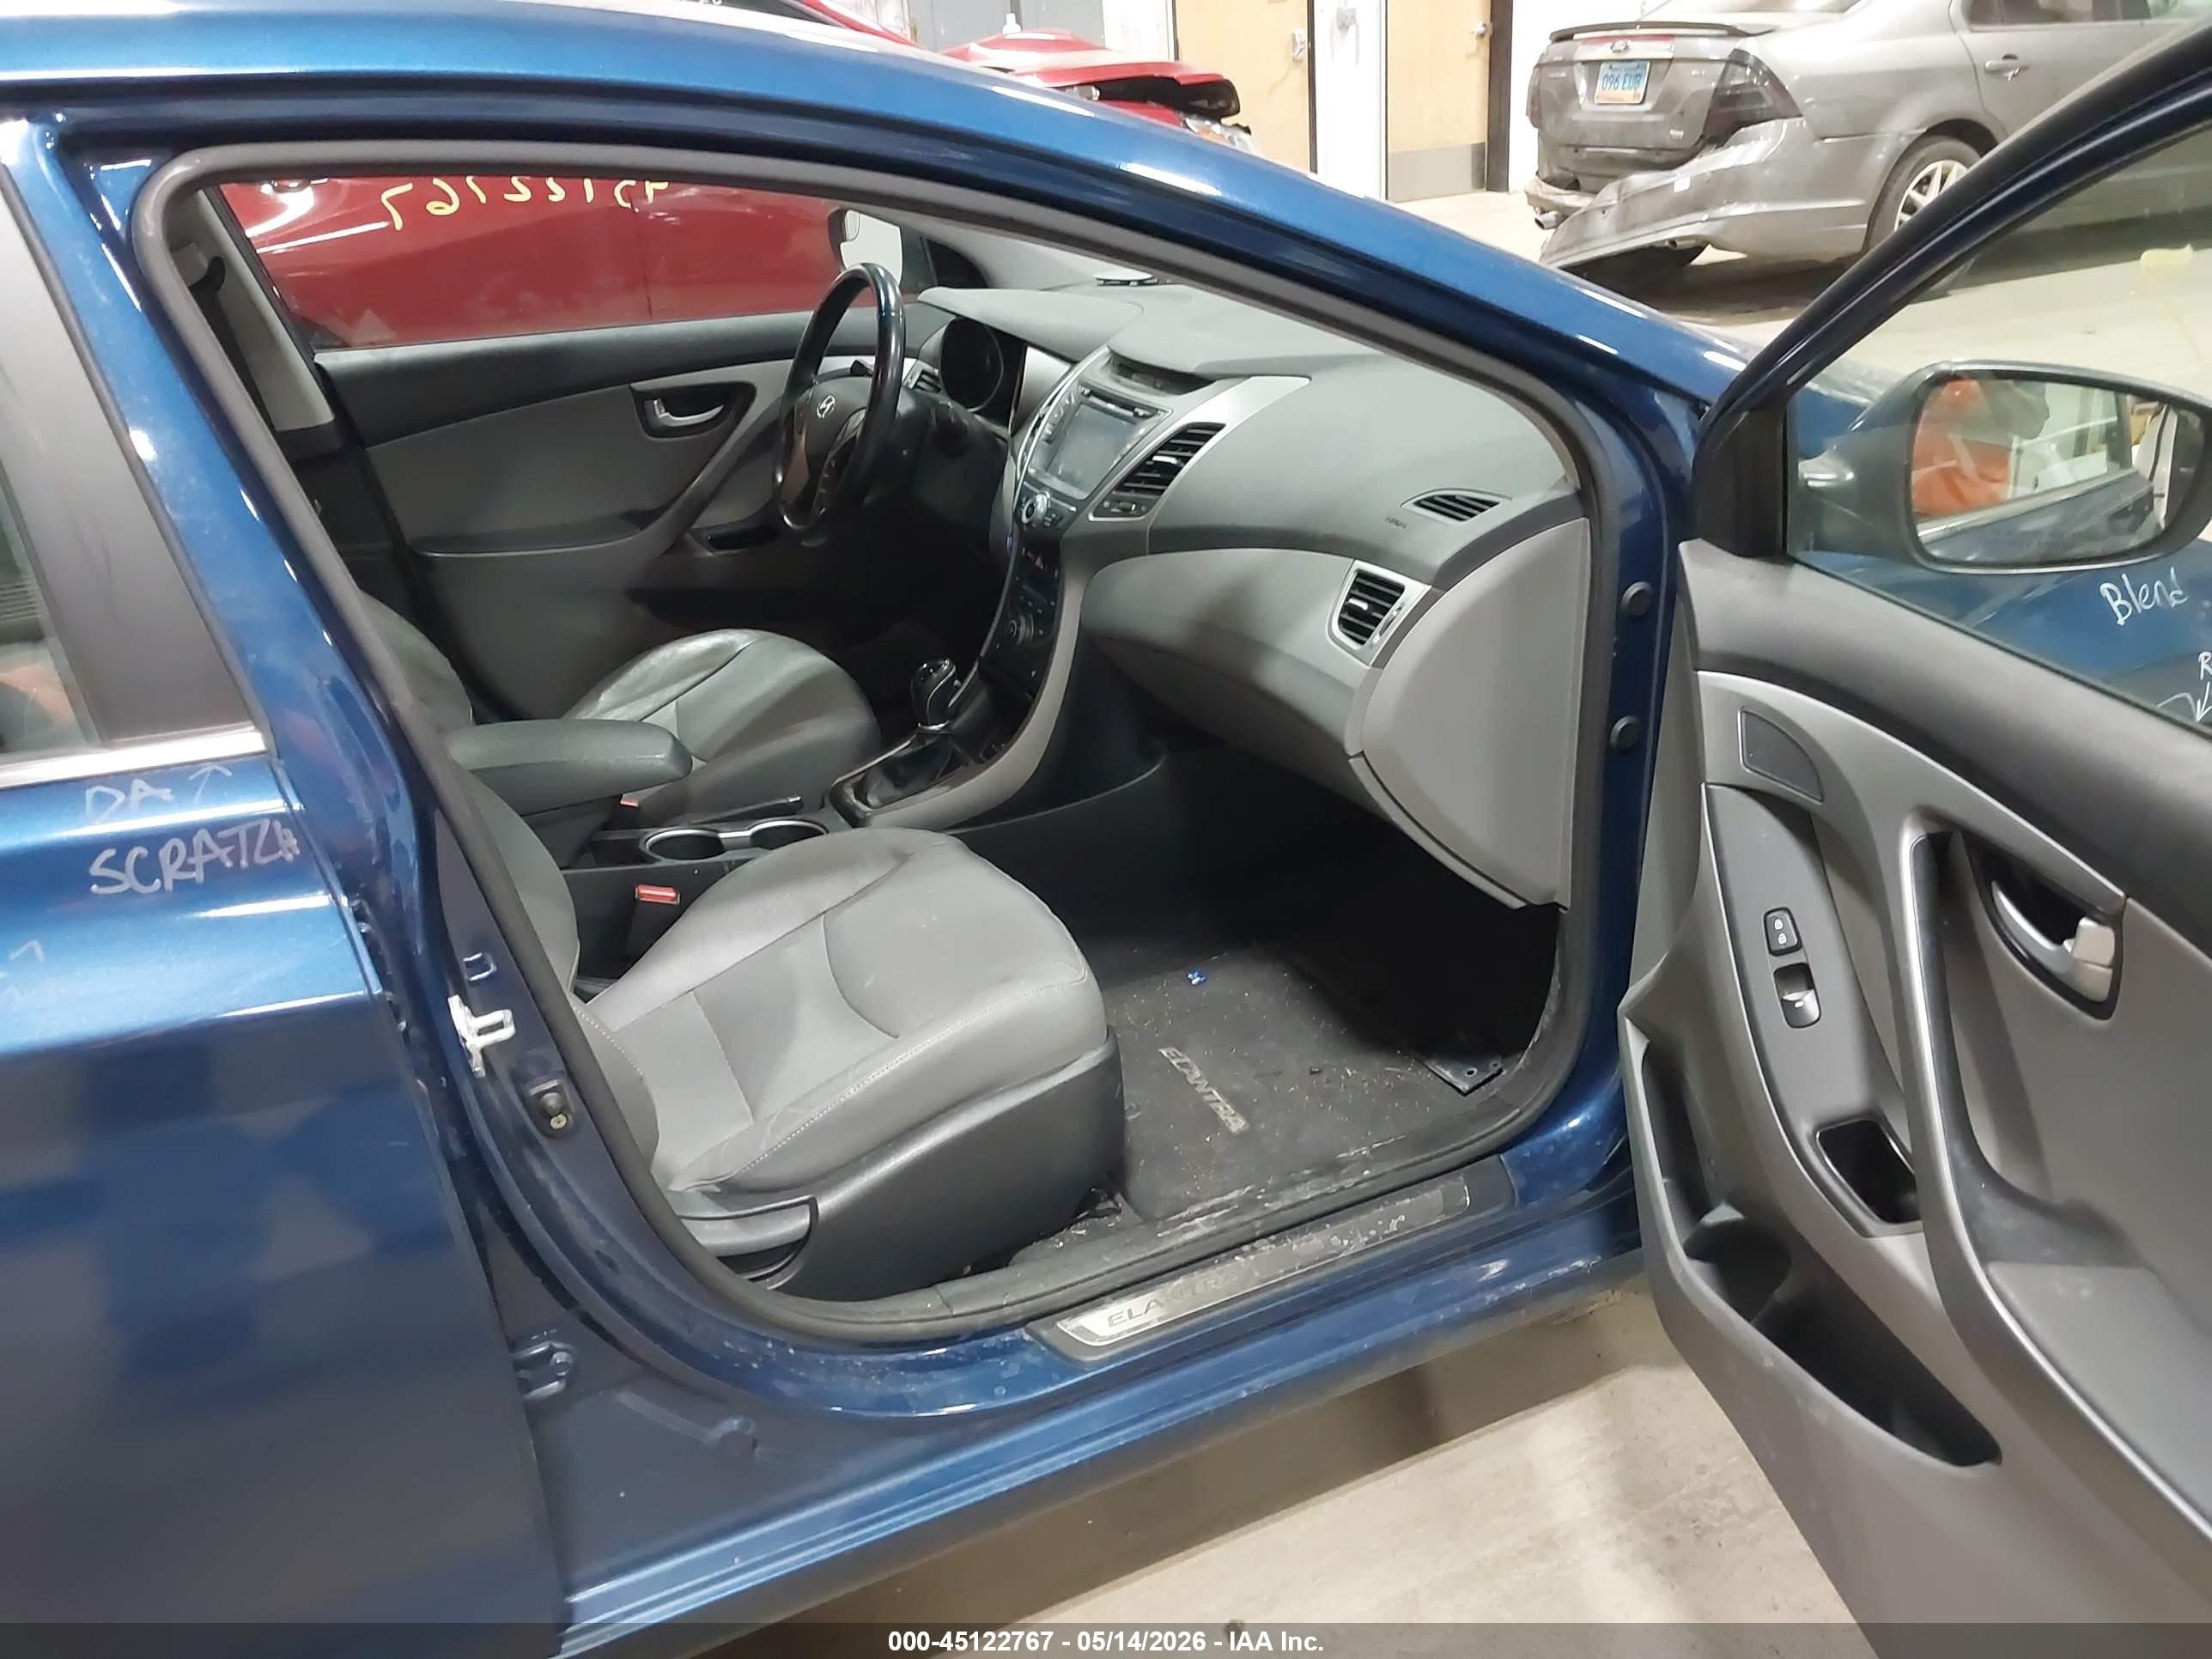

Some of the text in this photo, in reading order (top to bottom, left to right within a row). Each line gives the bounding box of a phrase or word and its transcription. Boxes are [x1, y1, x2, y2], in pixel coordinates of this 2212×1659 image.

[1601, 74, 1620, 90] 096
[2100, 566, 2189, 626] Blend
[85, 778, 173, 823] DA
[88, 818, 301, 895] SCRATCH
